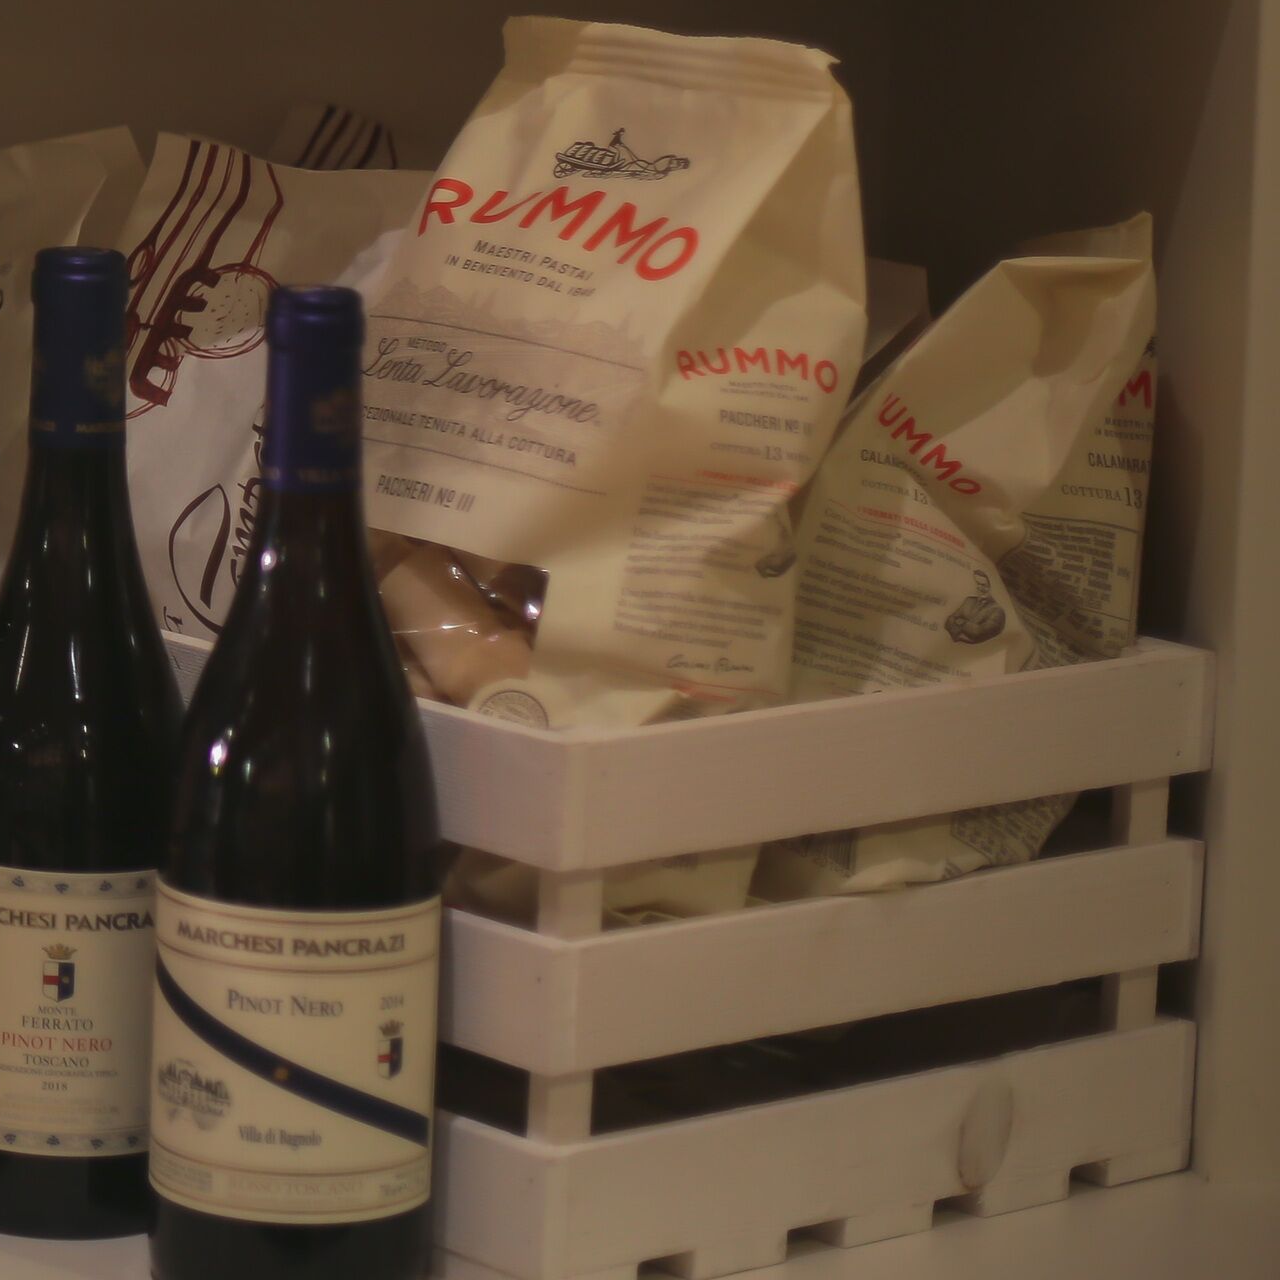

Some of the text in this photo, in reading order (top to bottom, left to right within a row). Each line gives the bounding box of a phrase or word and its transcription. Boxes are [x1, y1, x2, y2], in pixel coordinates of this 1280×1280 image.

[416, 177, 700, 282] RUMMO
[473, 239, 537, 265] MAESTRI
[444, 253, 563, 293] IN BENEVENTO DAL
[675, 346, 839, 395] RUMMO
[422, 347, 600, 422] Lavorazione
[419, 414, 467, 438] TENUTA
[470, 427, 505, 446] ALLA
[876, 391, 984, 498] UMMO
[1061, 484, 1123, 502] COTTURA
[64, 912, 155, 932] PANCRA
[176, 920, 407, 958] MARCHESI PANCRAZI
[20, 1014, 95, 1032] FERRATO
[37, 1004, 78, 1017] MONTE
[0, 1030, 114, 1053] PINOT NERO
[21, 1052, 91, 1069] TOSCANO
[40, 1080, 69, 1092] 2018
